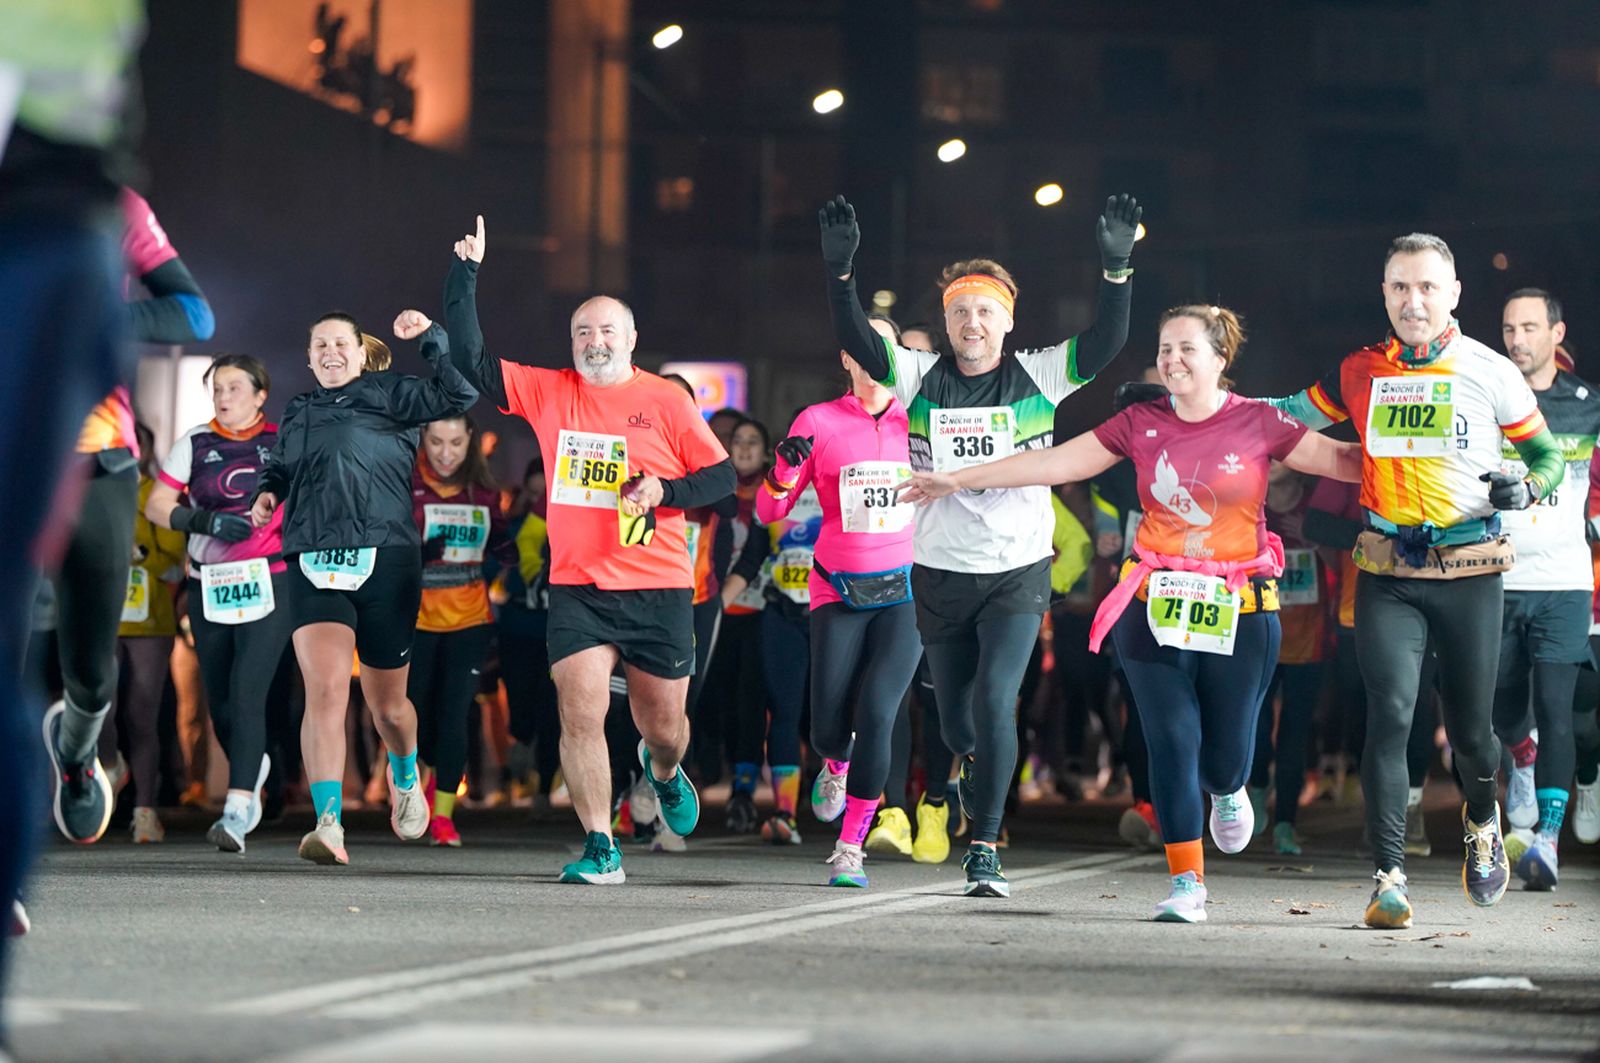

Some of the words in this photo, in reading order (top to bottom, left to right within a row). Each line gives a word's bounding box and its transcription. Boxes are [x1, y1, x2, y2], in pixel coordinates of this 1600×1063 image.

[1390, 385, 1414, 393] NOCHE
[1416, 385, 1424, 393] DE
[1379, 396, 1395, 404] SAN
[1387, 404, 1436, 429] 7102
[939, 427, 956, 435] SAN
[952, 435, 994, 457] 336
[569, 458, 618, 483] 5666
[848, 479, 864, 487] SAN
[863, 487, 898, 508] 337
[1169, 494, 1191, 513] 43
[213, 581, 261, 604] 12444
[1158, 588, 1176, 597] SAN
